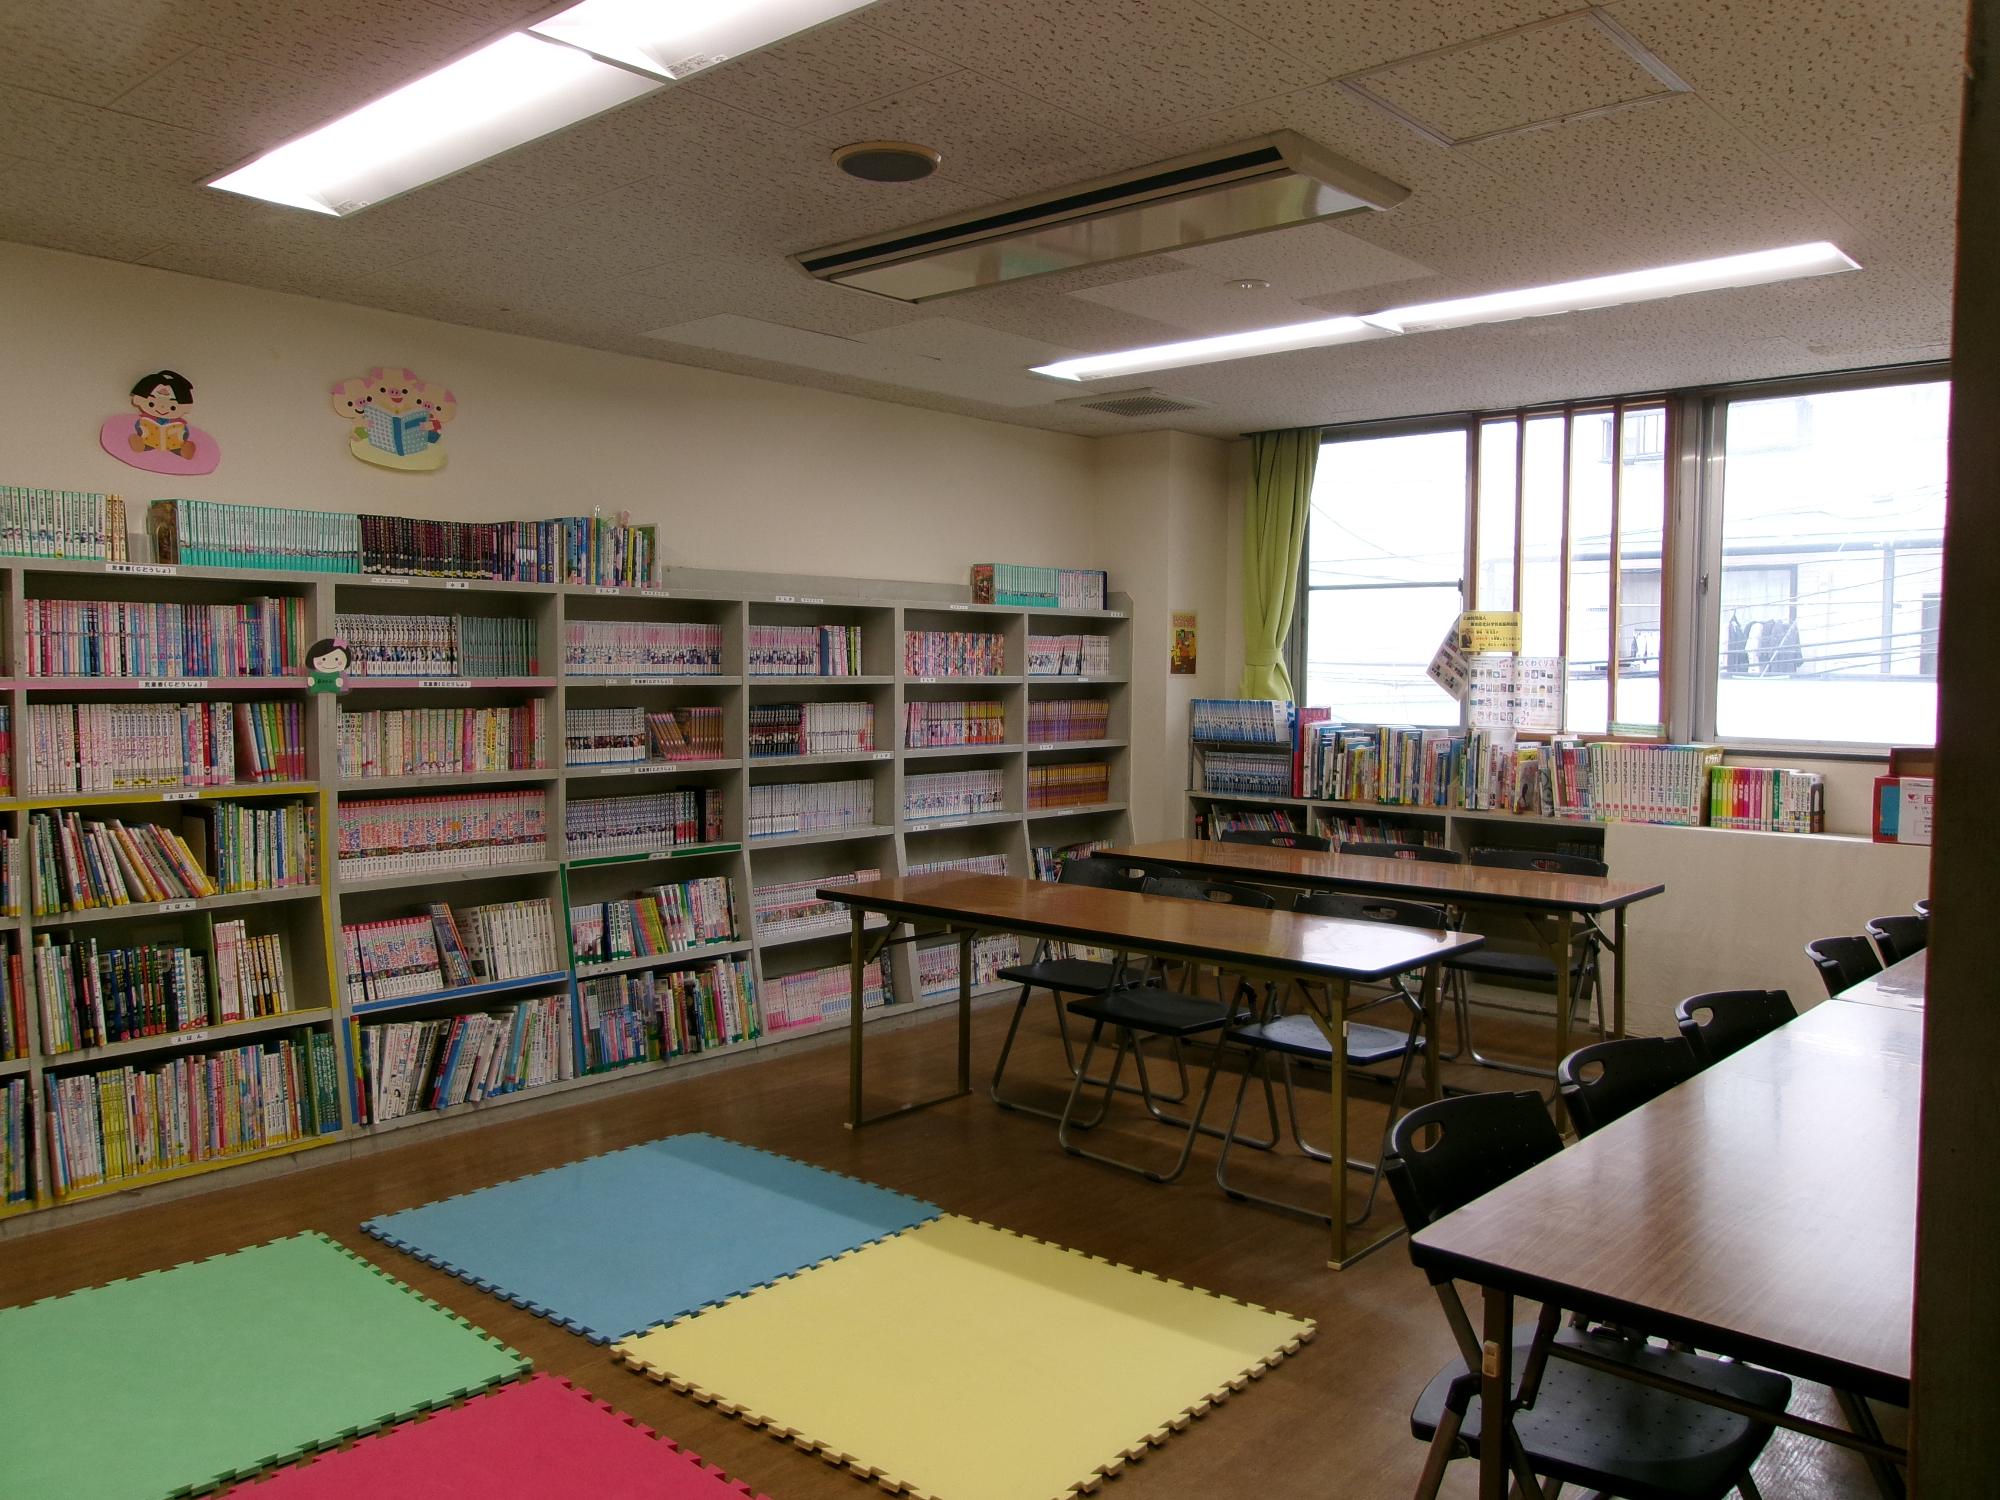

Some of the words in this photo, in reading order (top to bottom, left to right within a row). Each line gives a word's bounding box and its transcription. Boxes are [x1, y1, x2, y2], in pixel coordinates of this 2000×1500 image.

[1517, 659, 1562, 667] わくわくリスト
